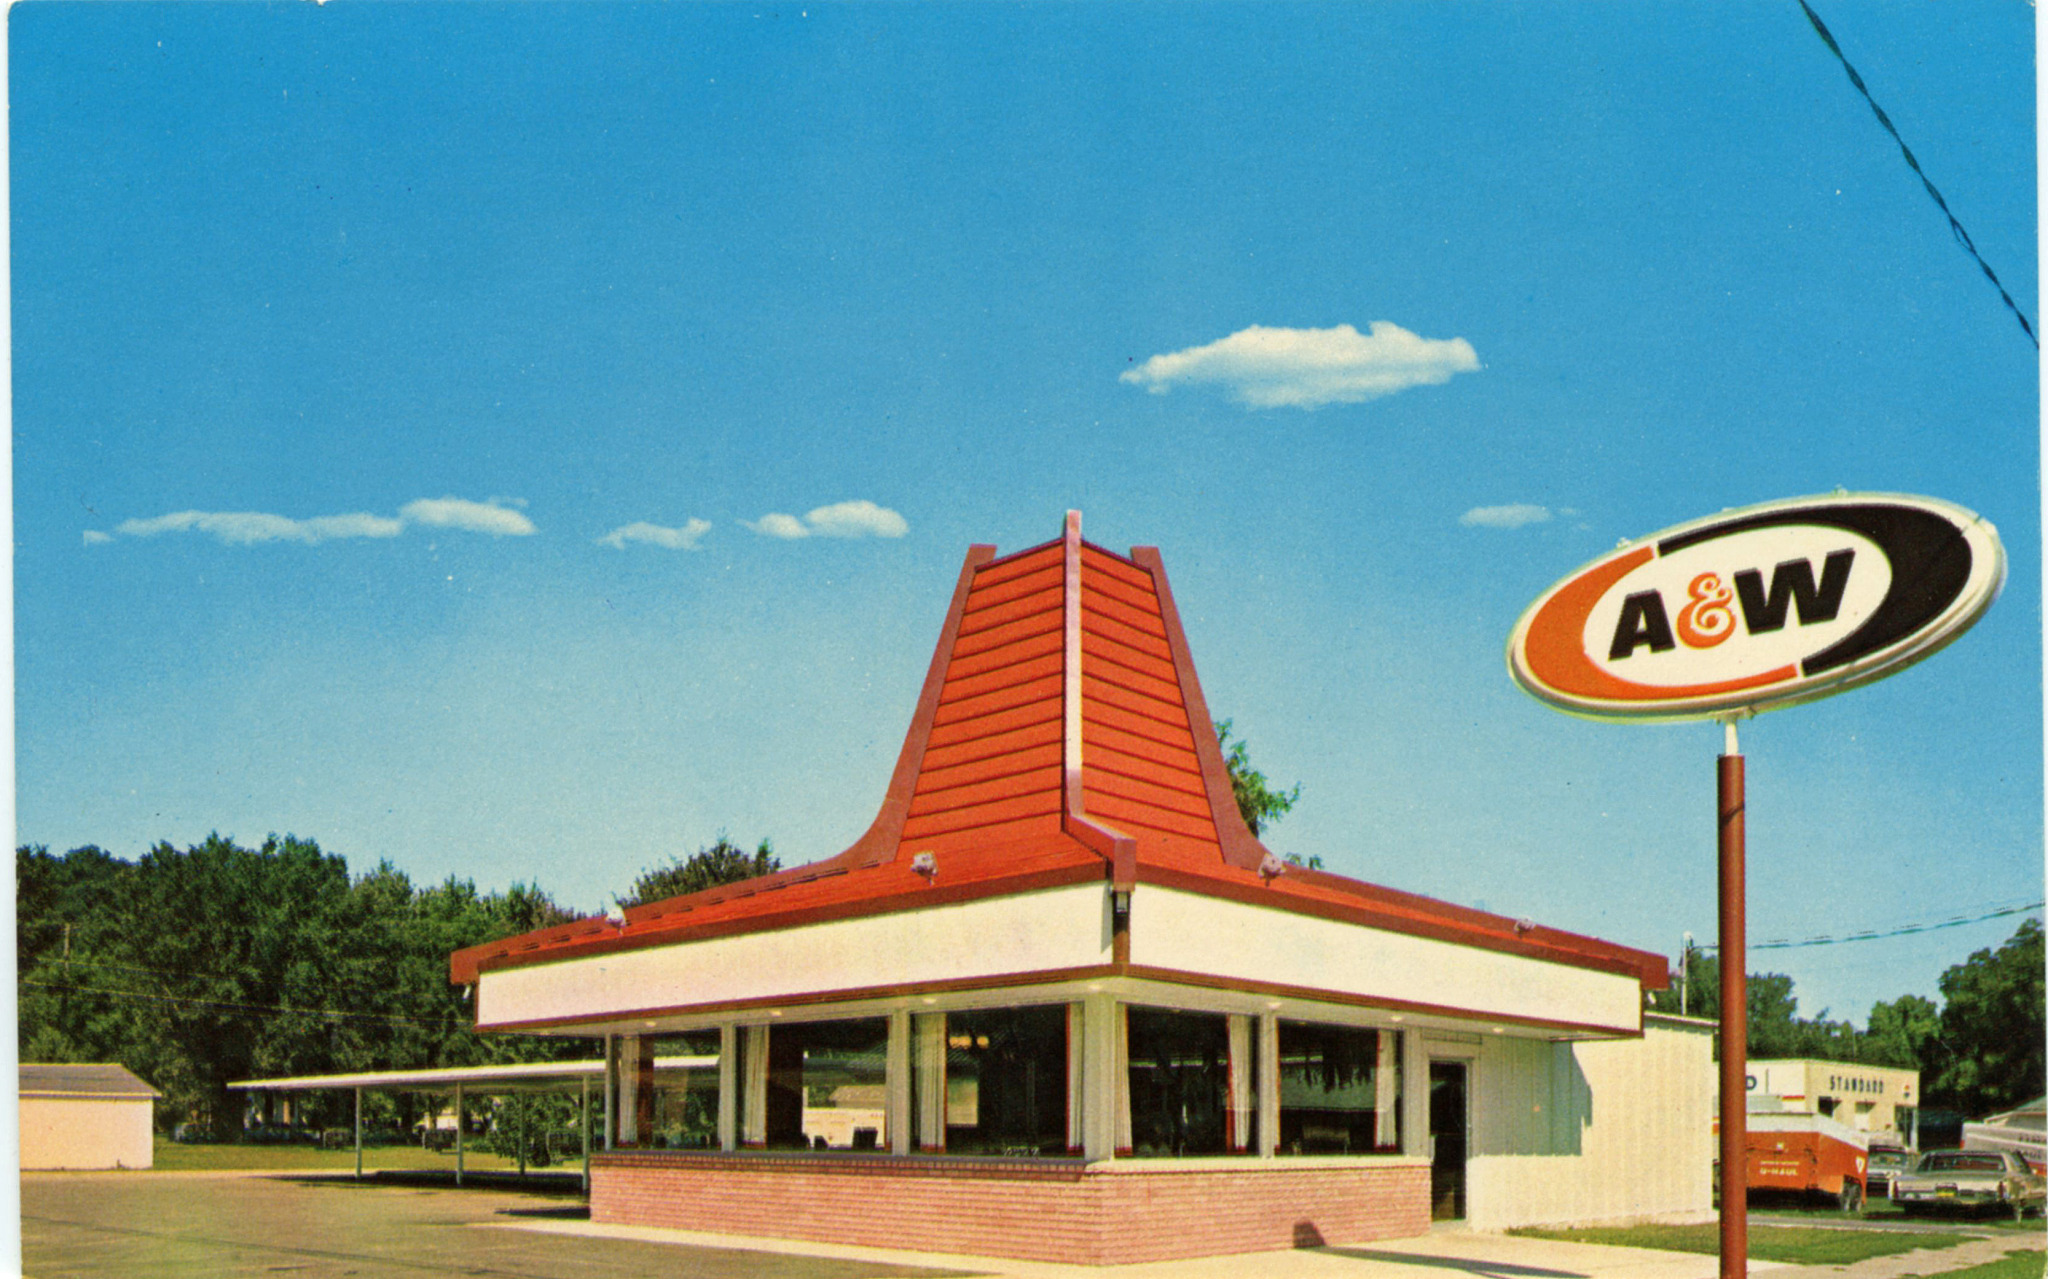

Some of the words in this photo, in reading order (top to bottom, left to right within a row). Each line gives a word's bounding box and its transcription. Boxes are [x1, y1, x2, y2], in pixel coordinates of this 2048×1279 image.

[1608, 548, 1856, 662] A&W
[1829, 1074, 1884, 1094] STANDARD
[1759, 1167, 1798, 1176] U-HAUL
